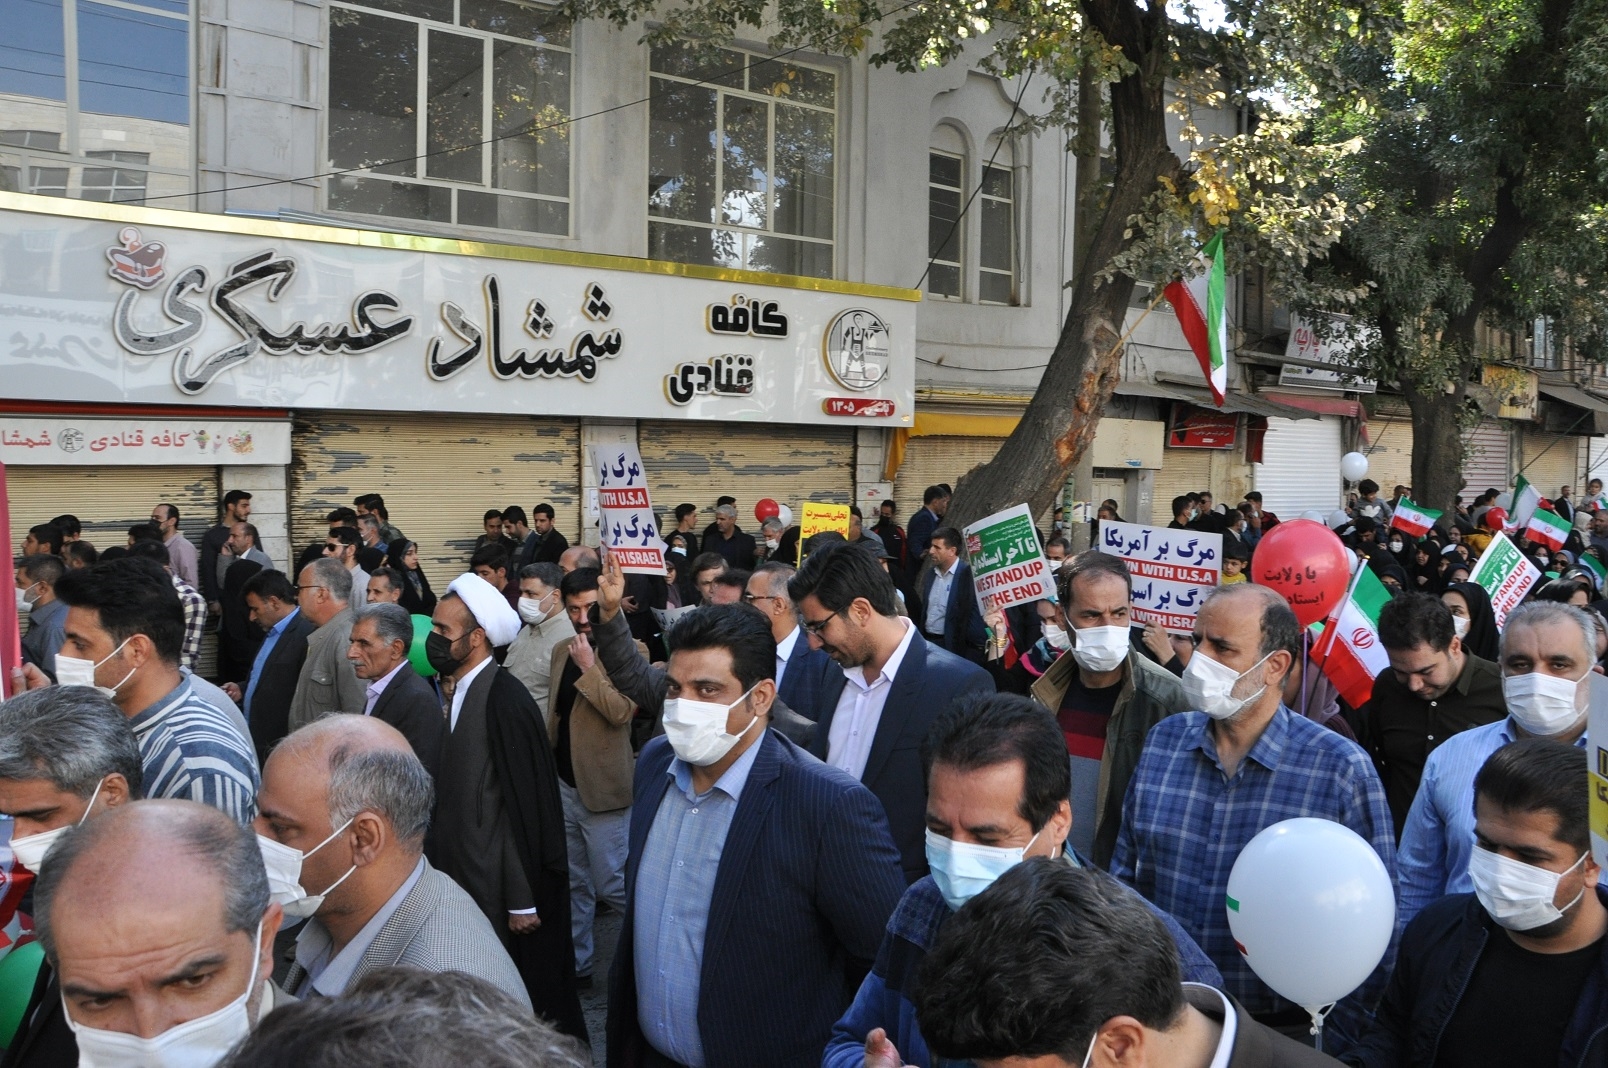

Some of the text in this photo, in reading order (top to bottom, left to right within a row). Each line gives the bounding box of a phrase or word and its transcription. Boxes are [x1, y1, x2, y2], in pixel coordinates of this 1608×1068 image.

[114, 249, 624, 395] شمشاد عسکری
[707, 293, 789, 338] کافه
[665, 354, 755, 406] قنادی
[0, 429, 52, 449] شمشا
[89, 429, 190, 452] کافه قنادی
[612, 452, 640, 486] مرگ
[618, 491, 646, 506] U.S.A
[612, 521, 622, 545] بر
[624, 513, 655, 547] مرگ
[1005, 537, 1024, 566] آخر
[1024, 536, 1036, 553] تا
[1105, 527, 1215, 565] مرگ بر آمریکا
[626, 551, 662, 566] ISRAEL
[986, 567, 1024, 590] STAND
[1024, 561, 1043, 578] UP
[1141, 561, 1174, 578] WITH
[1177, 569, 1212, 583] U.S.A
[1305, 566, 1316, 583] با
[1012, 582, 1042, 601] END
[1493, 575, 1517, 609] STAND
[1515, 561, 1527, 579] UP
[1513, 575, 1532, 598] END
[1154, 591, 1170, 609] بر
[1169, 616, 1195, 628] ISRA
